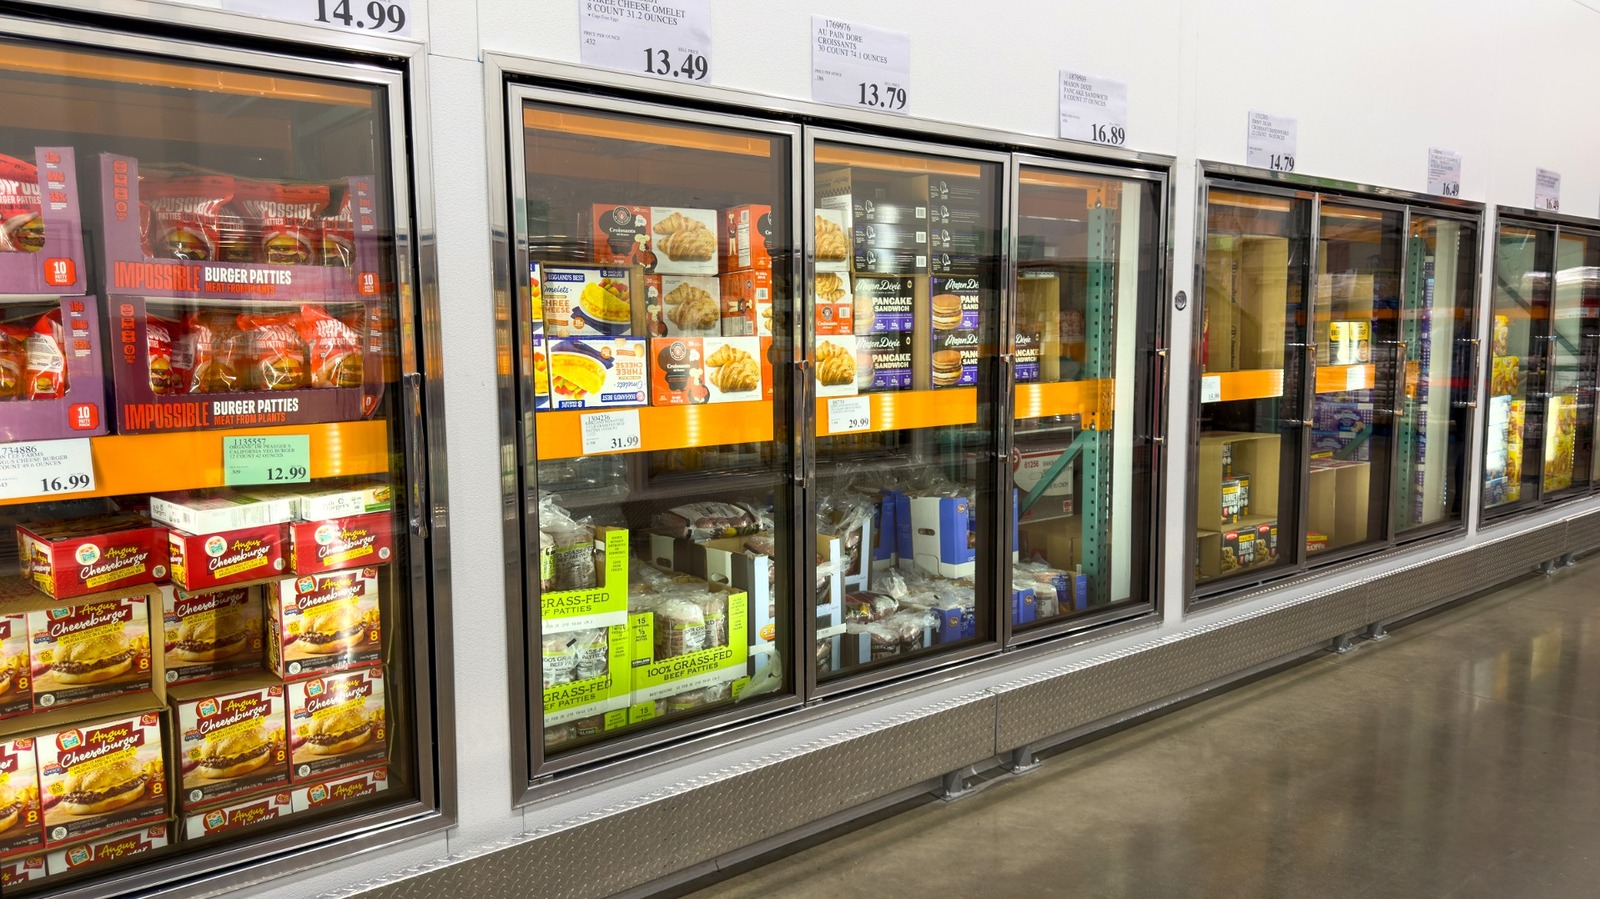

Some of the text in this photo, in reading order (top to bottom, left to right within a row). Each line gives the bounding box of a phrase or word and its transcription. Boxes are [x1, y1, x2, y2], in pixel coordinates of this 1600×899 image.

[594, 4, 625, 16] COUNT
[627, 10, 643, 20] 31.2
[644, 13, 678, 26] OUNCES
[617, 0, 686, 18] CHEESE OMELET
[314, 0, 406, 33] 14.99
[818, 28, 863, 43] AU PAIN DORE
[817, 36, 857, 50] CROISSANTS
[826, 45, 849, 57] COUNT
[863, 51, 888, 64] OUNCES
[643, 47, 708, 81] 13.49
[858, 82, 907, 110] 13.79
[1063, 87, 1085, 97] PANCAKE
[1091, 123, 1125, 145] 16.89
[1270, 153, 1295, 172] 14.79
[1442, 182, 1460, 197] 16.49
[53, 261, 67, 274] 10
[114, 260, 292, 292] IMPOSSIBLE BURGER PATTIES
[363, 274, 374, 286] 10
[572, 273, 584, 281] BEST
[205, 282, 276, 295] MEAT FROM PLANTS
[543, 299, 570, 307] HREE
[872, 297, 913, 306] PANCAKE
[543, 306, 571, 314] HEESE
[872, 353, 911, 362] PANCAKE
[615, 368, 643, 376] THREE
[874, 361, 909, 369] SANDWICH
[77, 406, 91, 419] 10
[124, 397, 299, 431] IMPOSSIBLE BURGER PATTIES
[213, 412, 286, 426] MEAT FROM PLANTS
[848, 417, 869, 429] 29.99
[234, 438, 267, 446] 1135557
[610, 435, 640, 449] 31.99
[1023, 460, 1040, 469] 61256
[267, 466, 307, 481] 12.99
[41, 474, 90, 492] 16.99
[339, 528, 367, 541] Angus
[104, 545, 138, 559] Angus
[231, 539, 262, 552] Angus
[208, 544, 271, 571] Cheeseburger
[80, 551, 149, 580] Cheeseburger
[321, 578, 353, 591] Angus
[298, 584, 362, 609] Cheeseburger
[79, 602, 117, 616] Angus
[176, 591, 246, 618] Cheeseburger
[553, 604, 592, 616] PATTIES
[50, 608, 129, 637] Cheeseburger
[370, 630, 378, 642] 8
[253, 638, 261, 649] 8
[139, 657, 149, 670] 8
[647, 649, 734, 678] 100% GRASS-FED
[663, 661, 719, 681] BEEF PATTIES
[18, 677, 29, 690] 8
[329, 679, 360, 693] Angus
[543, 679, 613, 704] GRASS-FED
[224, 698, 259, 712] Angus
[558, 693, 596, 708] PATTIES
[199, 703, 268, 735] Cheeseburger
[90, 729, 129, 744] Angus
[376, 729, 385, 740] 8
[61, 733, 140, 769] Cheeseburger
[276, 750, 285, 761] 8
[152, 782, 163, 795] 8
[333, 782, 363, 797] Angus
[27, 809, 38, 823] 8
[232, 807, 265, 823] Angus
[99, 840, 136, 858] Angus
